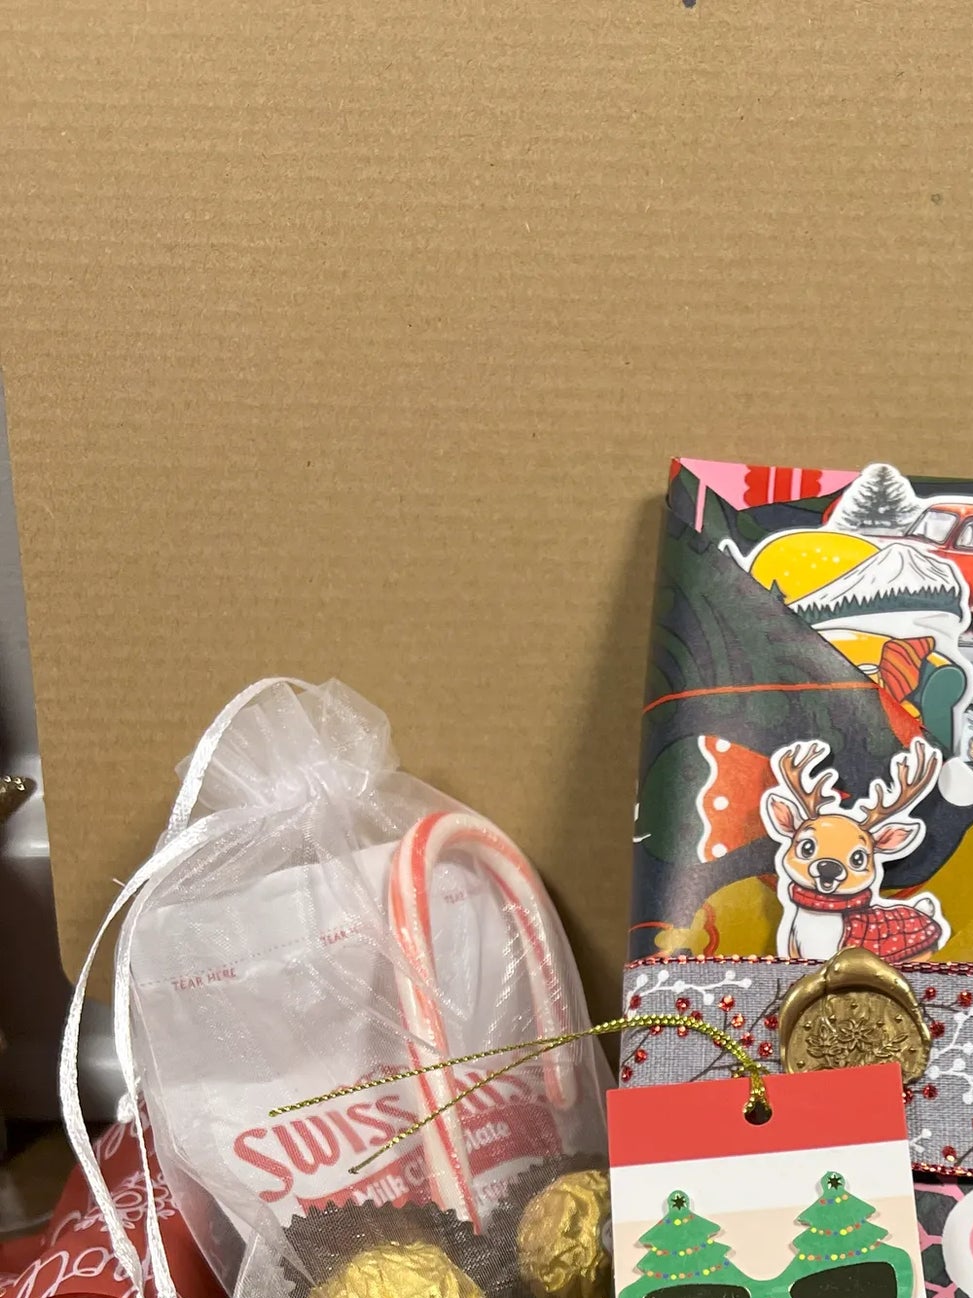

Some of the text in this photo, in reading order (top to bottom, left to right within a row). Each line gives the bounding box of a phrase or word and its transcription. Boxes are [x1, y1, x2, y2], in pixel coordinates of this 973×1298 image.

[171, 967, 237, 992] TEAR HERE
[233, 1094, 421, 1203] SWISS
